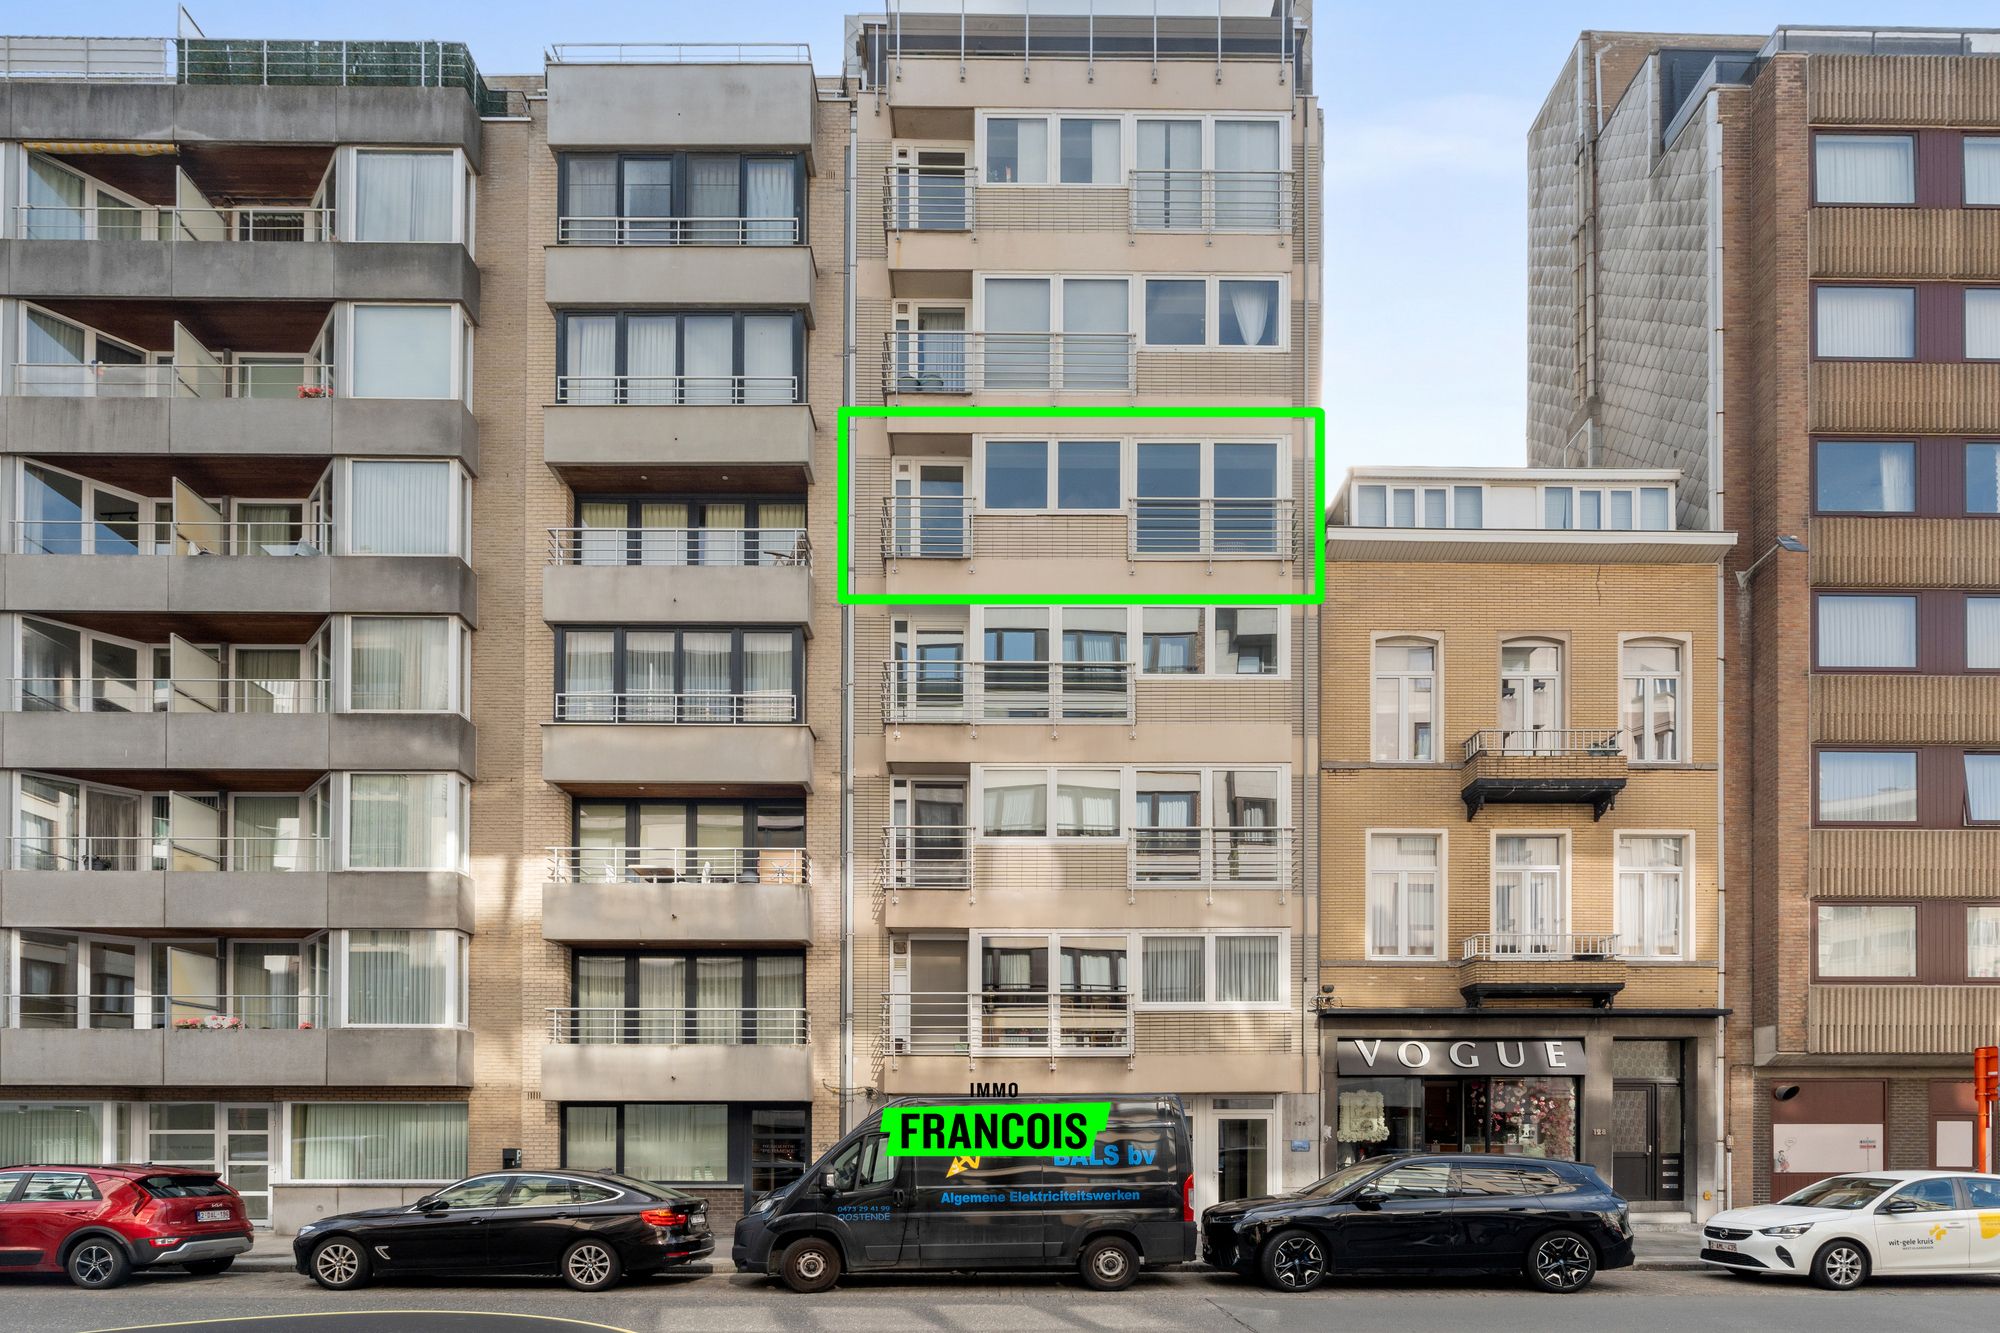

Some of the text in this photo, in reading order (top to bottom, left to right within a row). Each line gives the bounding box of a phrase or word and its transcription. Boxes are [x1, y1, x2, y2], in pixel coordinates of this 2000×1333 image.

[1354, 1039, 1567, 1068] VOGUE
[1592, 1128, 1607, 1136] 128
[1127, 1144, 1157, 1166] bv
[940, 1189, 1141, 1206] Algemene Elektriciteitswerken
[837, 1213, 891, 1221] OOSTENDE
[1888, 1237, 1934, 1248] wit-gele kruis
